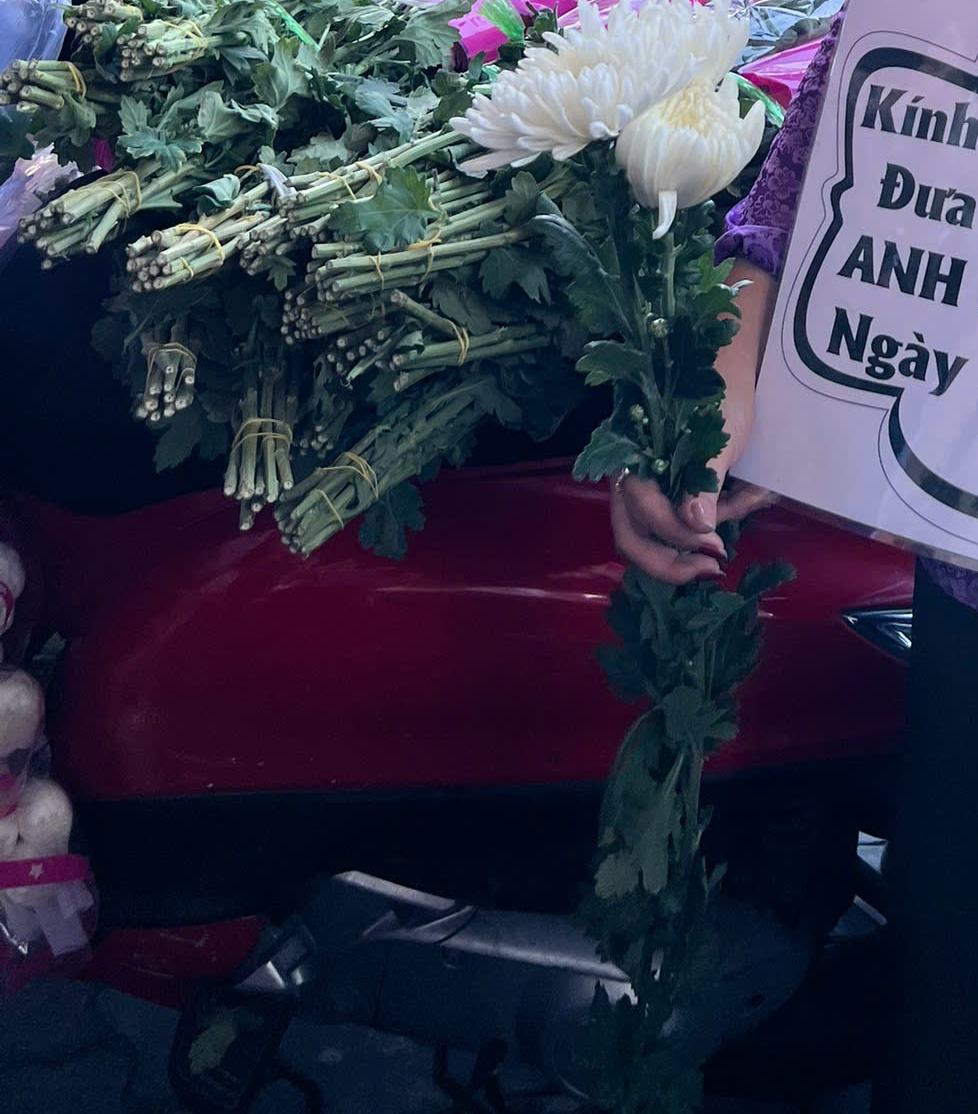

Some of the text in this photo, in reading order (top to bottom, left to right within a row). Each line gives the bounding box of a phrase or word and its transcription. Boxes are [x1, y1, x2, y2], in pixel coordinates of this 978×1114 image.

[876, 162, 977, 230] Đưa
[836, 234, 968, 308] ANH
[826, 306, 969, 397] Ngày
